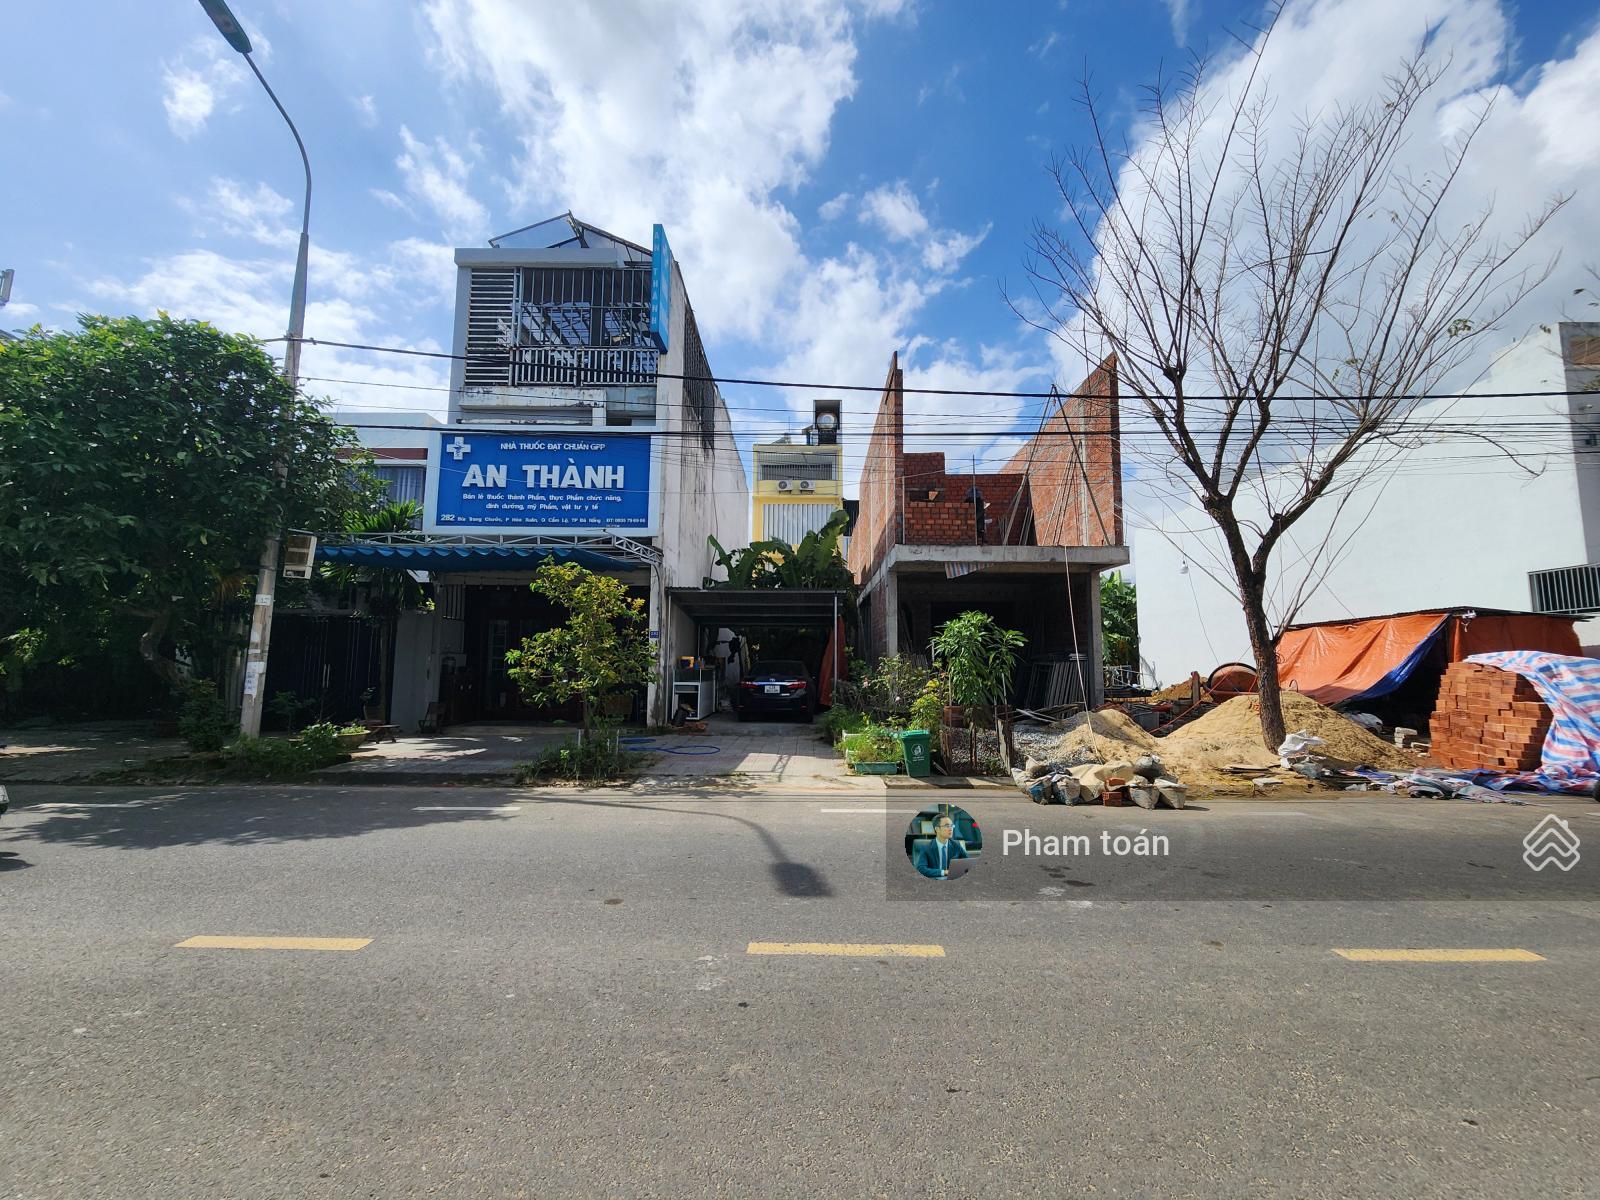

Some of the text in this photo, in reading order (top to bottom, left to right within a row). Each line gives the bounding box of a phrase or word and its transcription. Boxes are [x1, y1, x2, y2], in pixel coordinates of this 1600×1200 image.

[500, 441, 517, 450] NHÀ
[519, 440, 546, 450] THUỐC
[547, 444, 562, 452] ĐẠT
[563, 441, 589, 451] CHUẨN
[462, 457, 625, 489] AN THÀNH
